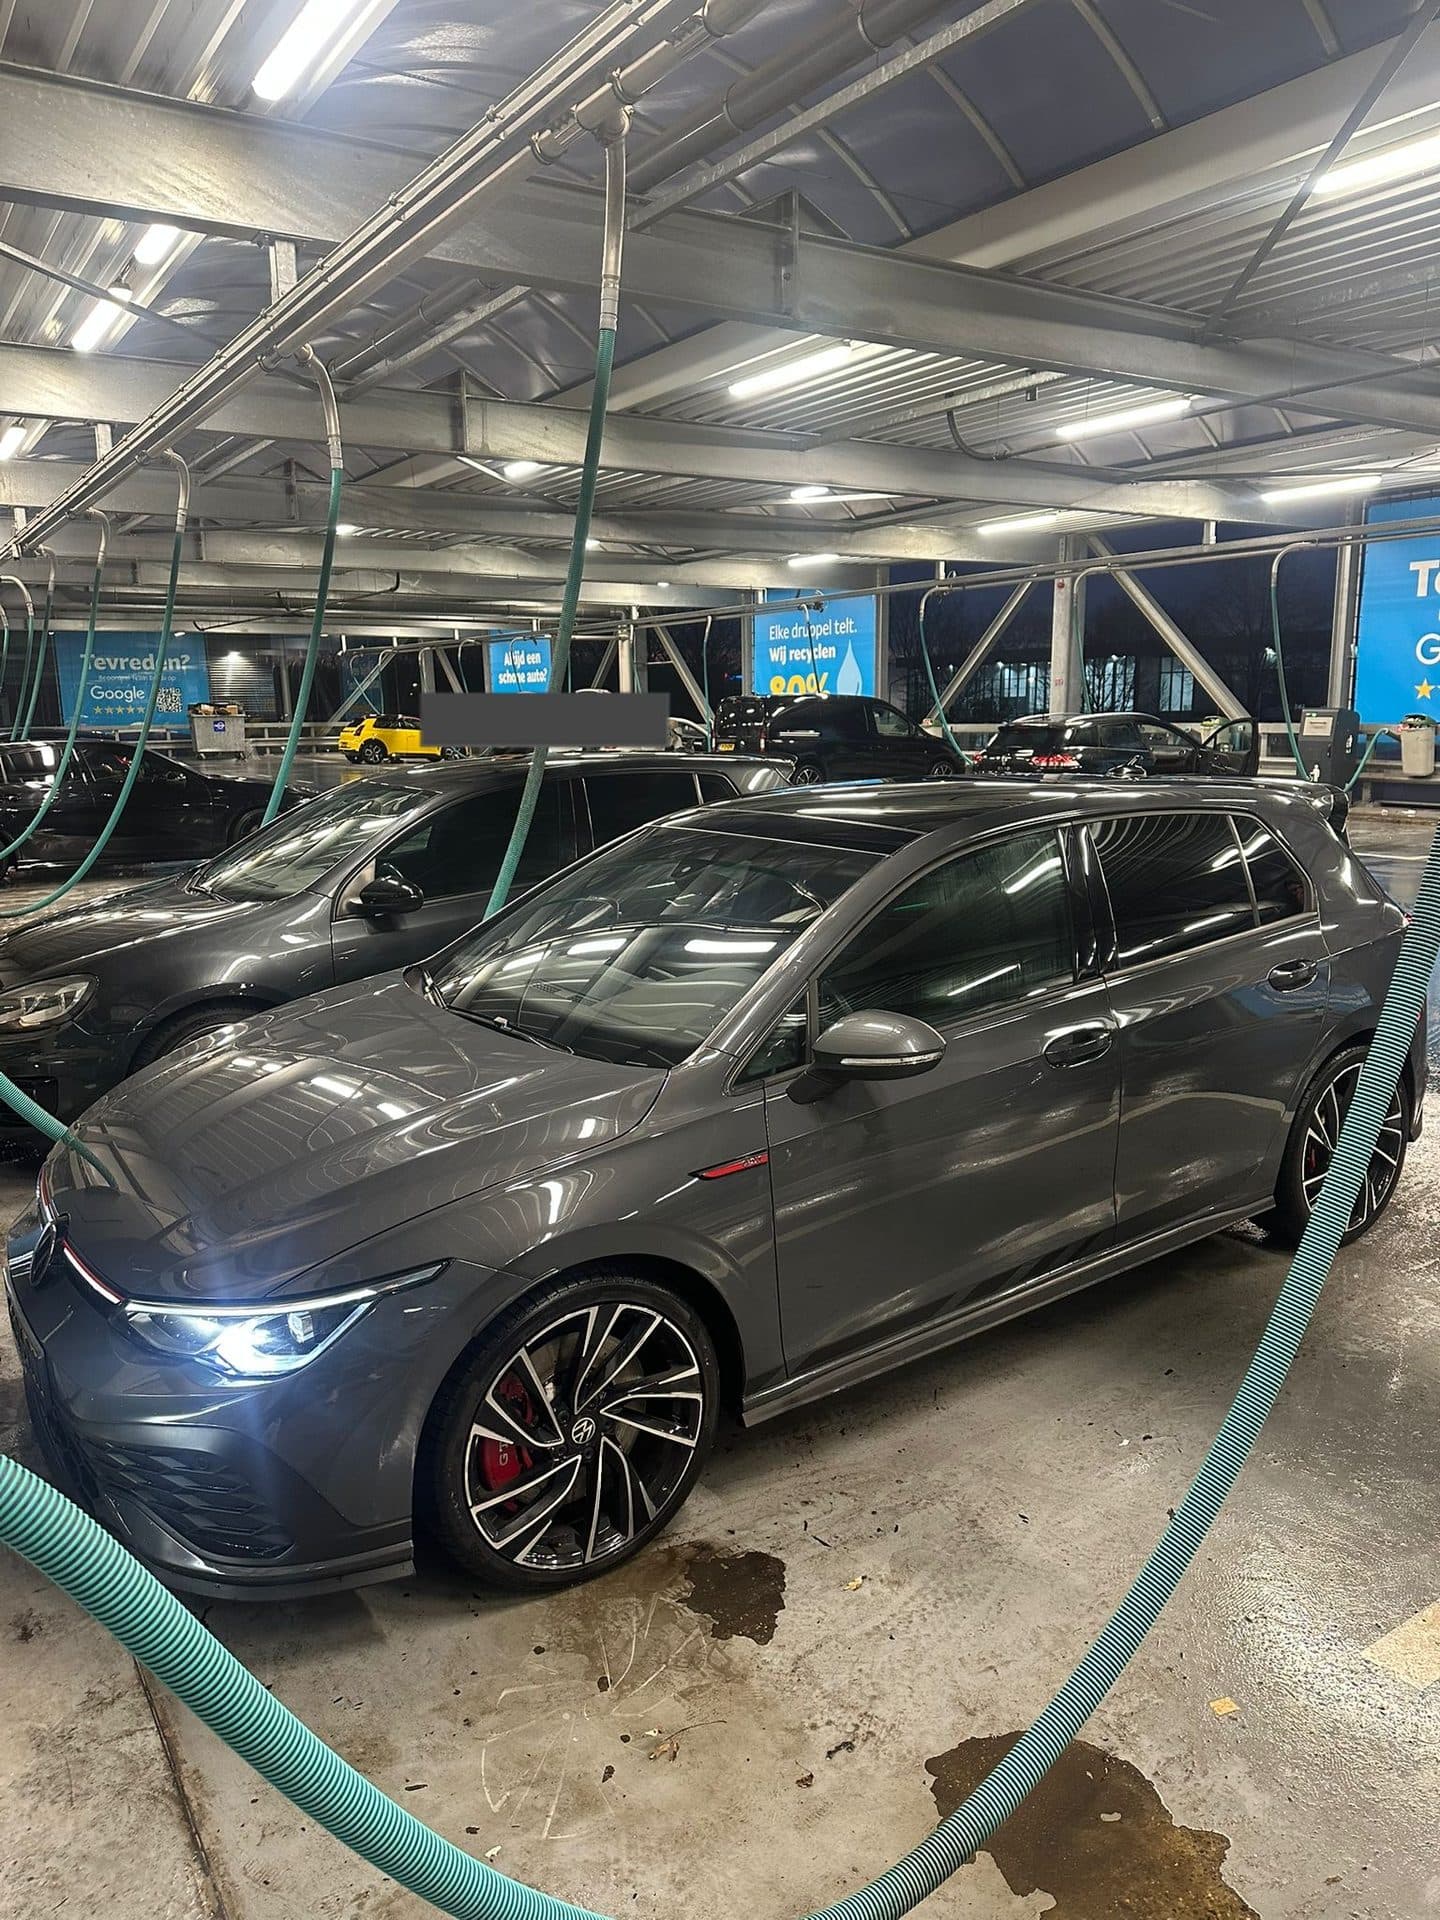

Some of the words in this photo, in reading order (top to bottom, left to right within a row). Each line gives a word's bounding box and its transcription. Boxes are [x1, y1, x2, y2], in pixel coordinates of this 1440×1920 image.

[769, 624, 790, 640] Elke
[791, 619, 832, 640] druppel
[834, 616, 858, 634] telt.
[526, 653, 541, 665] een
[769, 645, 787, 666] Wij
[789, 643, 836, 664] recyclen
[498, 669, 525, 684] schone
[526, 667, 548, 683] auto?
[90, 685, 145, 703] Google
